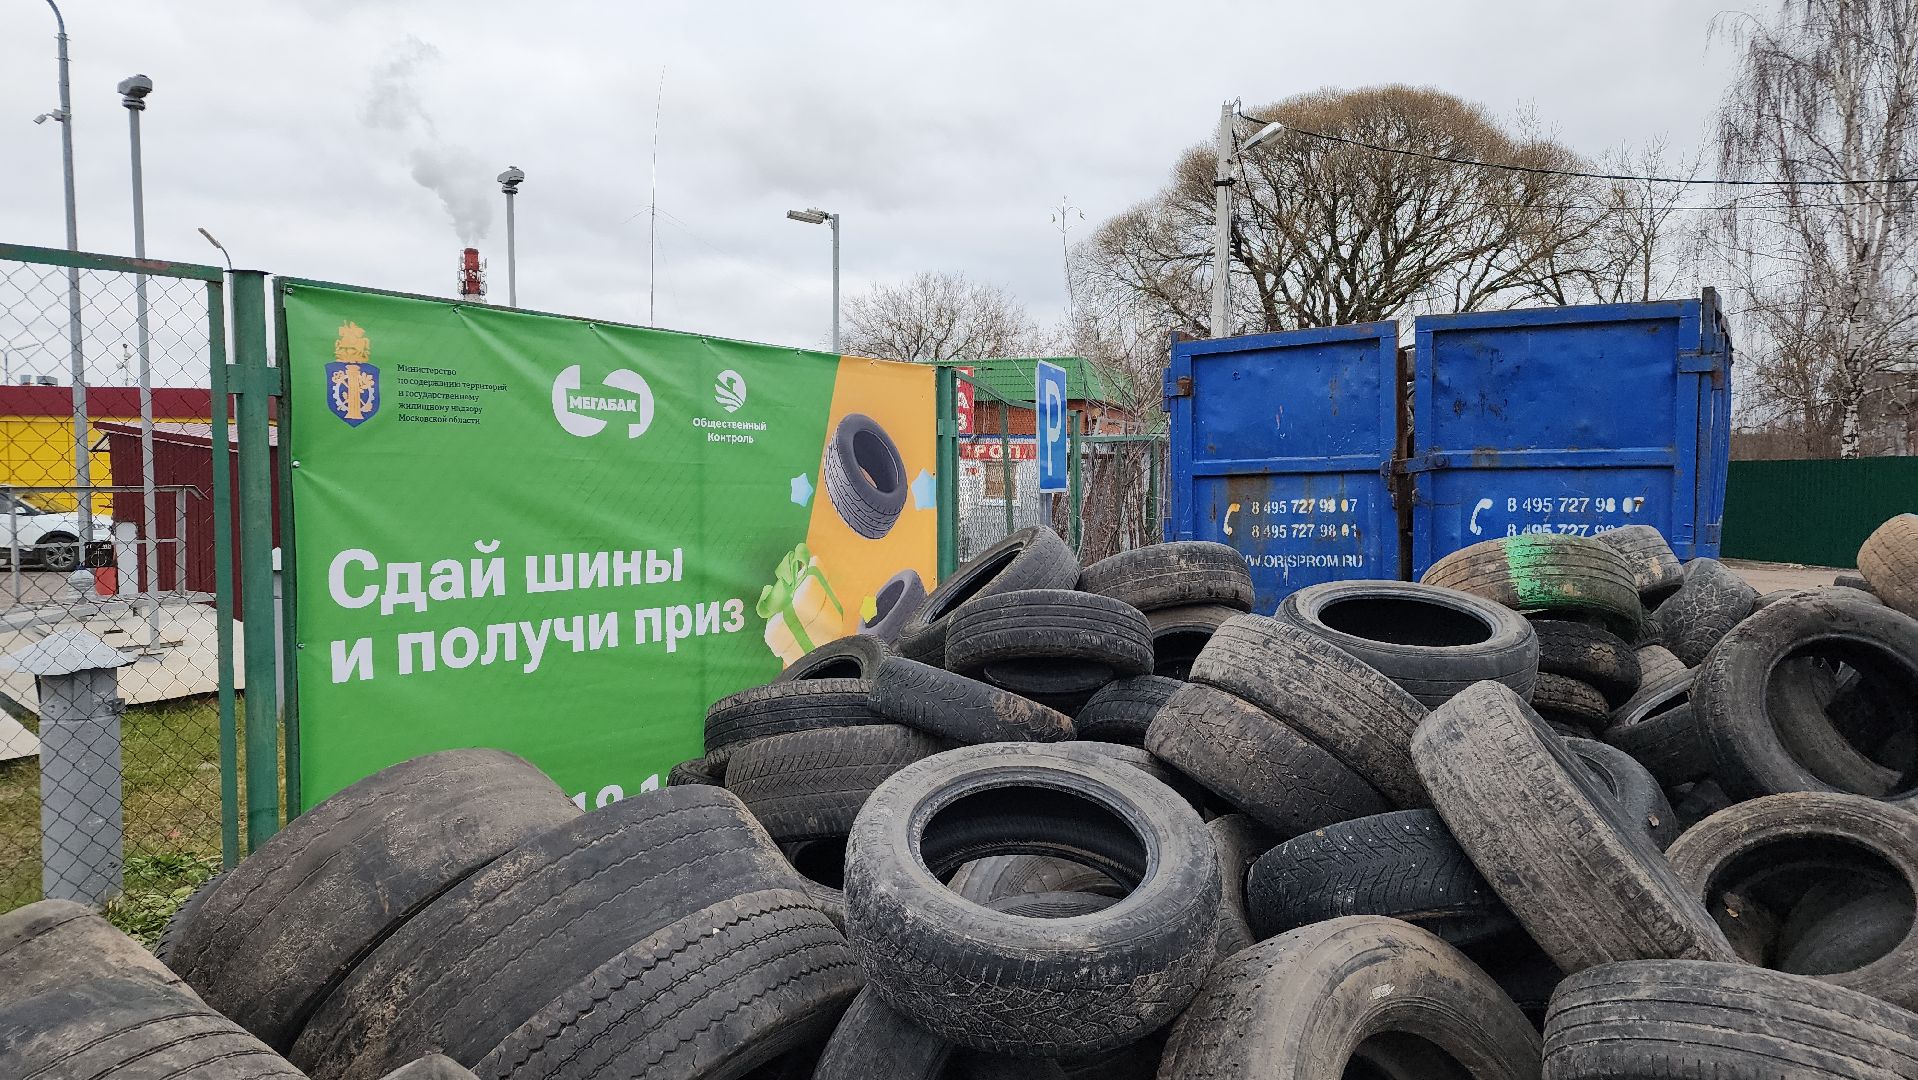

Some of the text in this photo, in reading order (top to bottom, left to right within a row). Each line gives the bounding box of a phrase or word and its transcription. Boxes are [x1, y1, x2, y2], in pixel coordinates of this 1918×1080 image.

[397, 363, 457, 376] Министерство
[410, 378, 461, 388] содержанию
[462, 382, 507, 392] территорий
[405, 391, 480, 402] государственному
[398, 402, 483, 414] жилищному надзору
[569, 395, 637, 413] МЕГАБАК
[398, 413, 480, 424] Московской области
[692, 417, 767, 431] Общественный
[1045, 378, 1062, 477] P
[707, 432, 754, 445] Контроль
[1251, 501, 1260, 515] 8
[1263, 500, 1287, 514] 495
[1290, 499, 1316, 514] 727
[1507, 497, 1517, 513] 8
[1522, 497, 1553, 513] 495
[1558, 497, 1590, 513] 727
[1595, 497, 1616, 513] 98
[1251, 524, 1260, 538] 8
[1263, 524, 1287, 538] 495
[1290, 523, 1316, 538] 727
[1320, 523, 1337, 538] 98
[1506, 523, 1517, 537] 8
[1557, 523, 1590, 537] 727
[1244, 553, 1363, 568] W.ORISPROM.RU
[328, 539, 682, 616] Сдай шины
[330, 598, 745, 684] и получи приз
